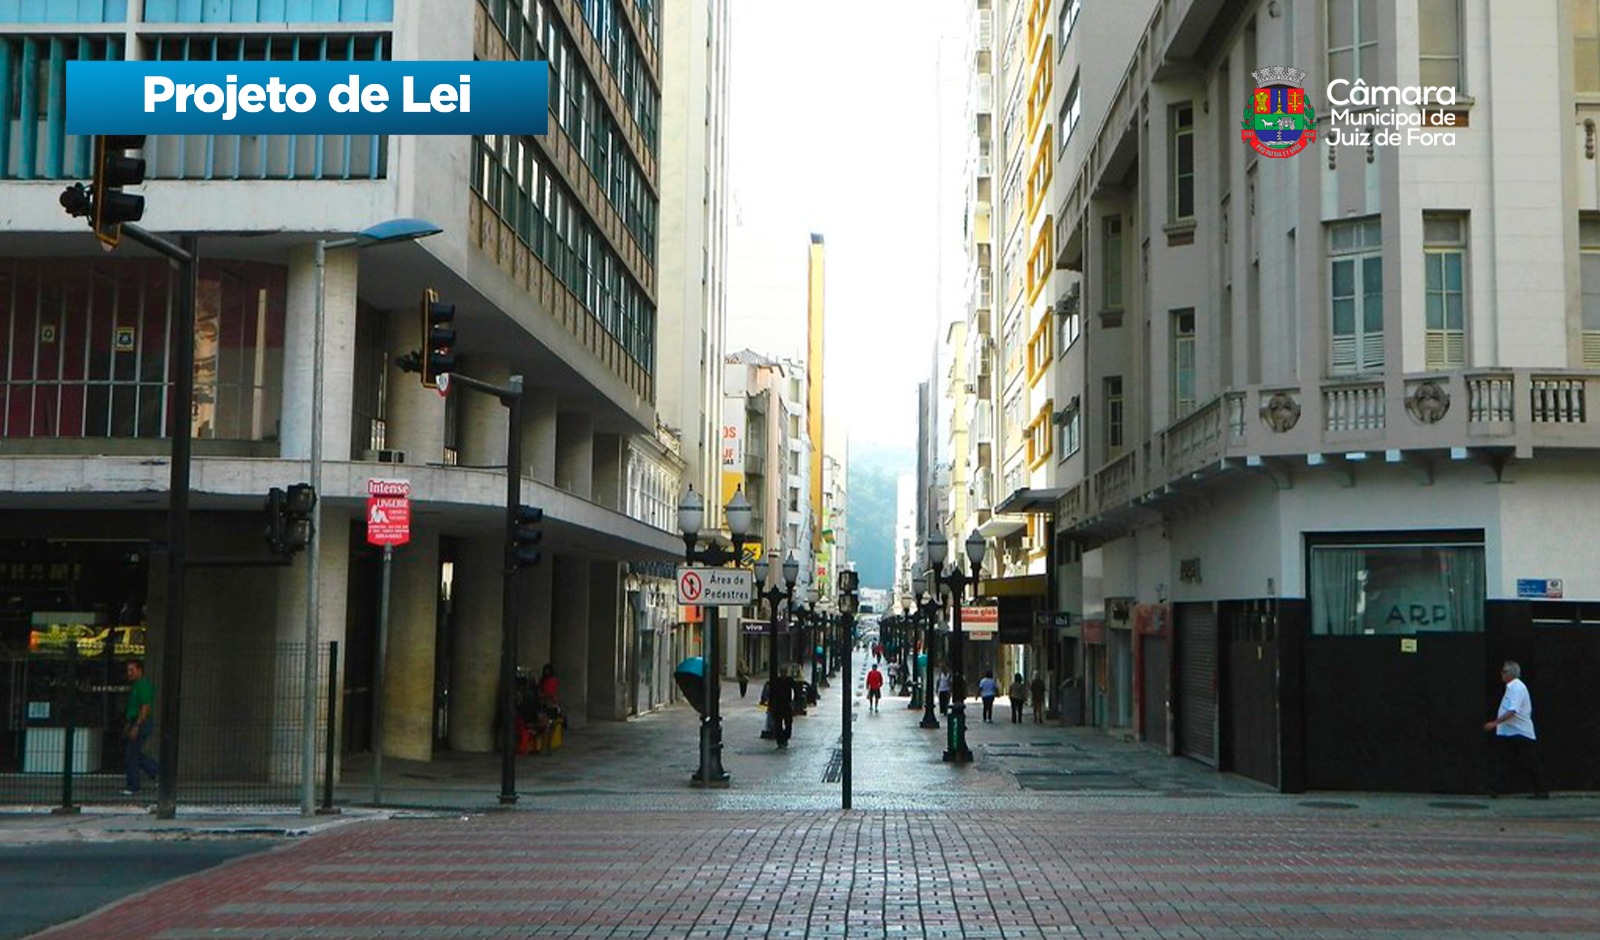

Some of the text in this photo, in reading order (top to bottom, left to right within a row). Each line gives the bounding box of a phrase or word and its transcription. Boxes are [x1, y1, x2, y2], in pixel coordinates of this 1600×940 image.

[368, 480, 410, 495] Intense
[709, 570, 745, 585] Área de
[704, 587, 749, 600] Pedestres
